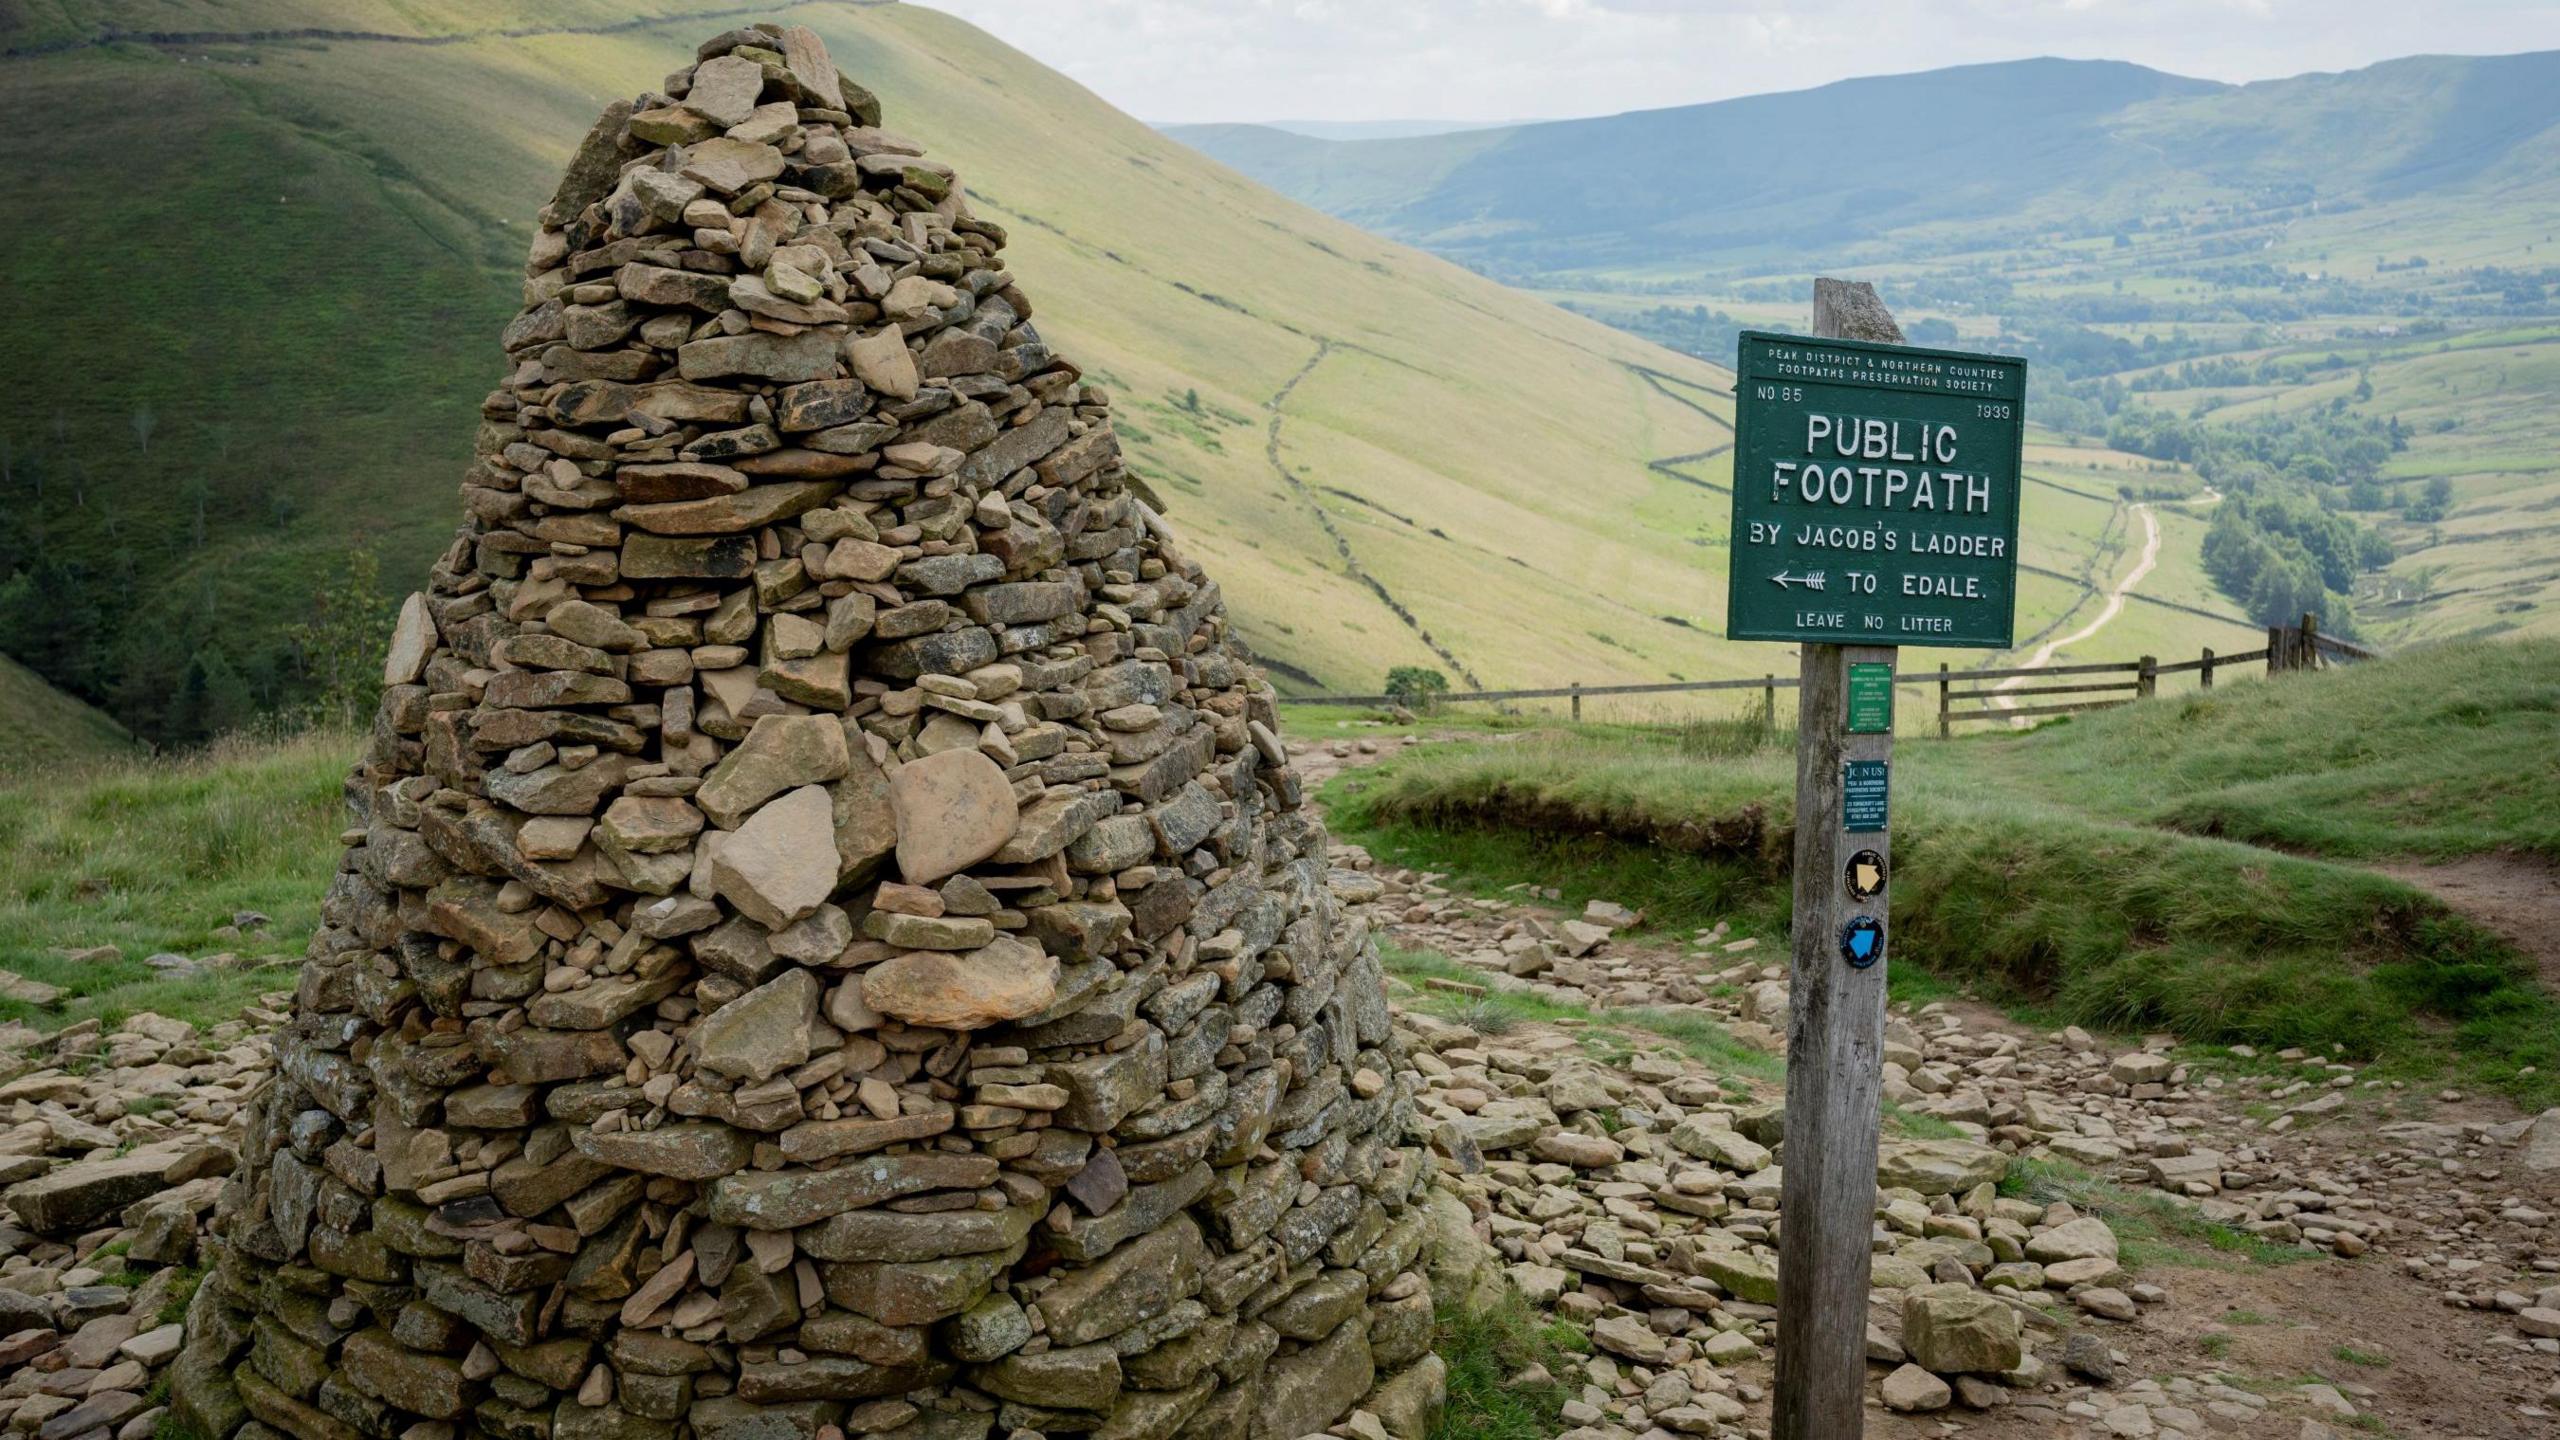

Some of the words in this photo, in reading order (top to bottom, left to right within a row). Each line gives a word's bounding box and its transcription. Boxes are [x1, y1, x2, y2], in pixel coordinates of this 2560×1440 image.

[1768, 348, 1798, 360] PEAK
[1806, 352, 1860, 366] DISTRICT
[1867, 358, 1874, 368] &
[1881, 360, 1942, 375] NORTHERN
[1949, 366, 2005, 379] COUNTIES
[1757, 386, 1775, 400] NO
[1778, 364, 1844, 379] FOOTPATHS
[1852, 370, 1938, 387] PRESERVATION
[1945, 379, 1993, 393] SOCIETY
[1976, 404, 2010, 419] 1939
[1807, 414, 1957, 463] PUBLIC
[1772, 462, 1990, 513] FOOTPATH
[1749, 522, 1781, 545] BY
[1797, 521, 1897, 551] JACOB'S
[1911, 532, 2005, 557] LADDER
[1847, 572, 1877, 593] TO
[1903, 574, 1987, 599] EDALE.
[1796, 613, 1844, 628] LEAVE
[1864, 615, 1884, 630] NO
[1901, 616, 1952, 632] LITTER
